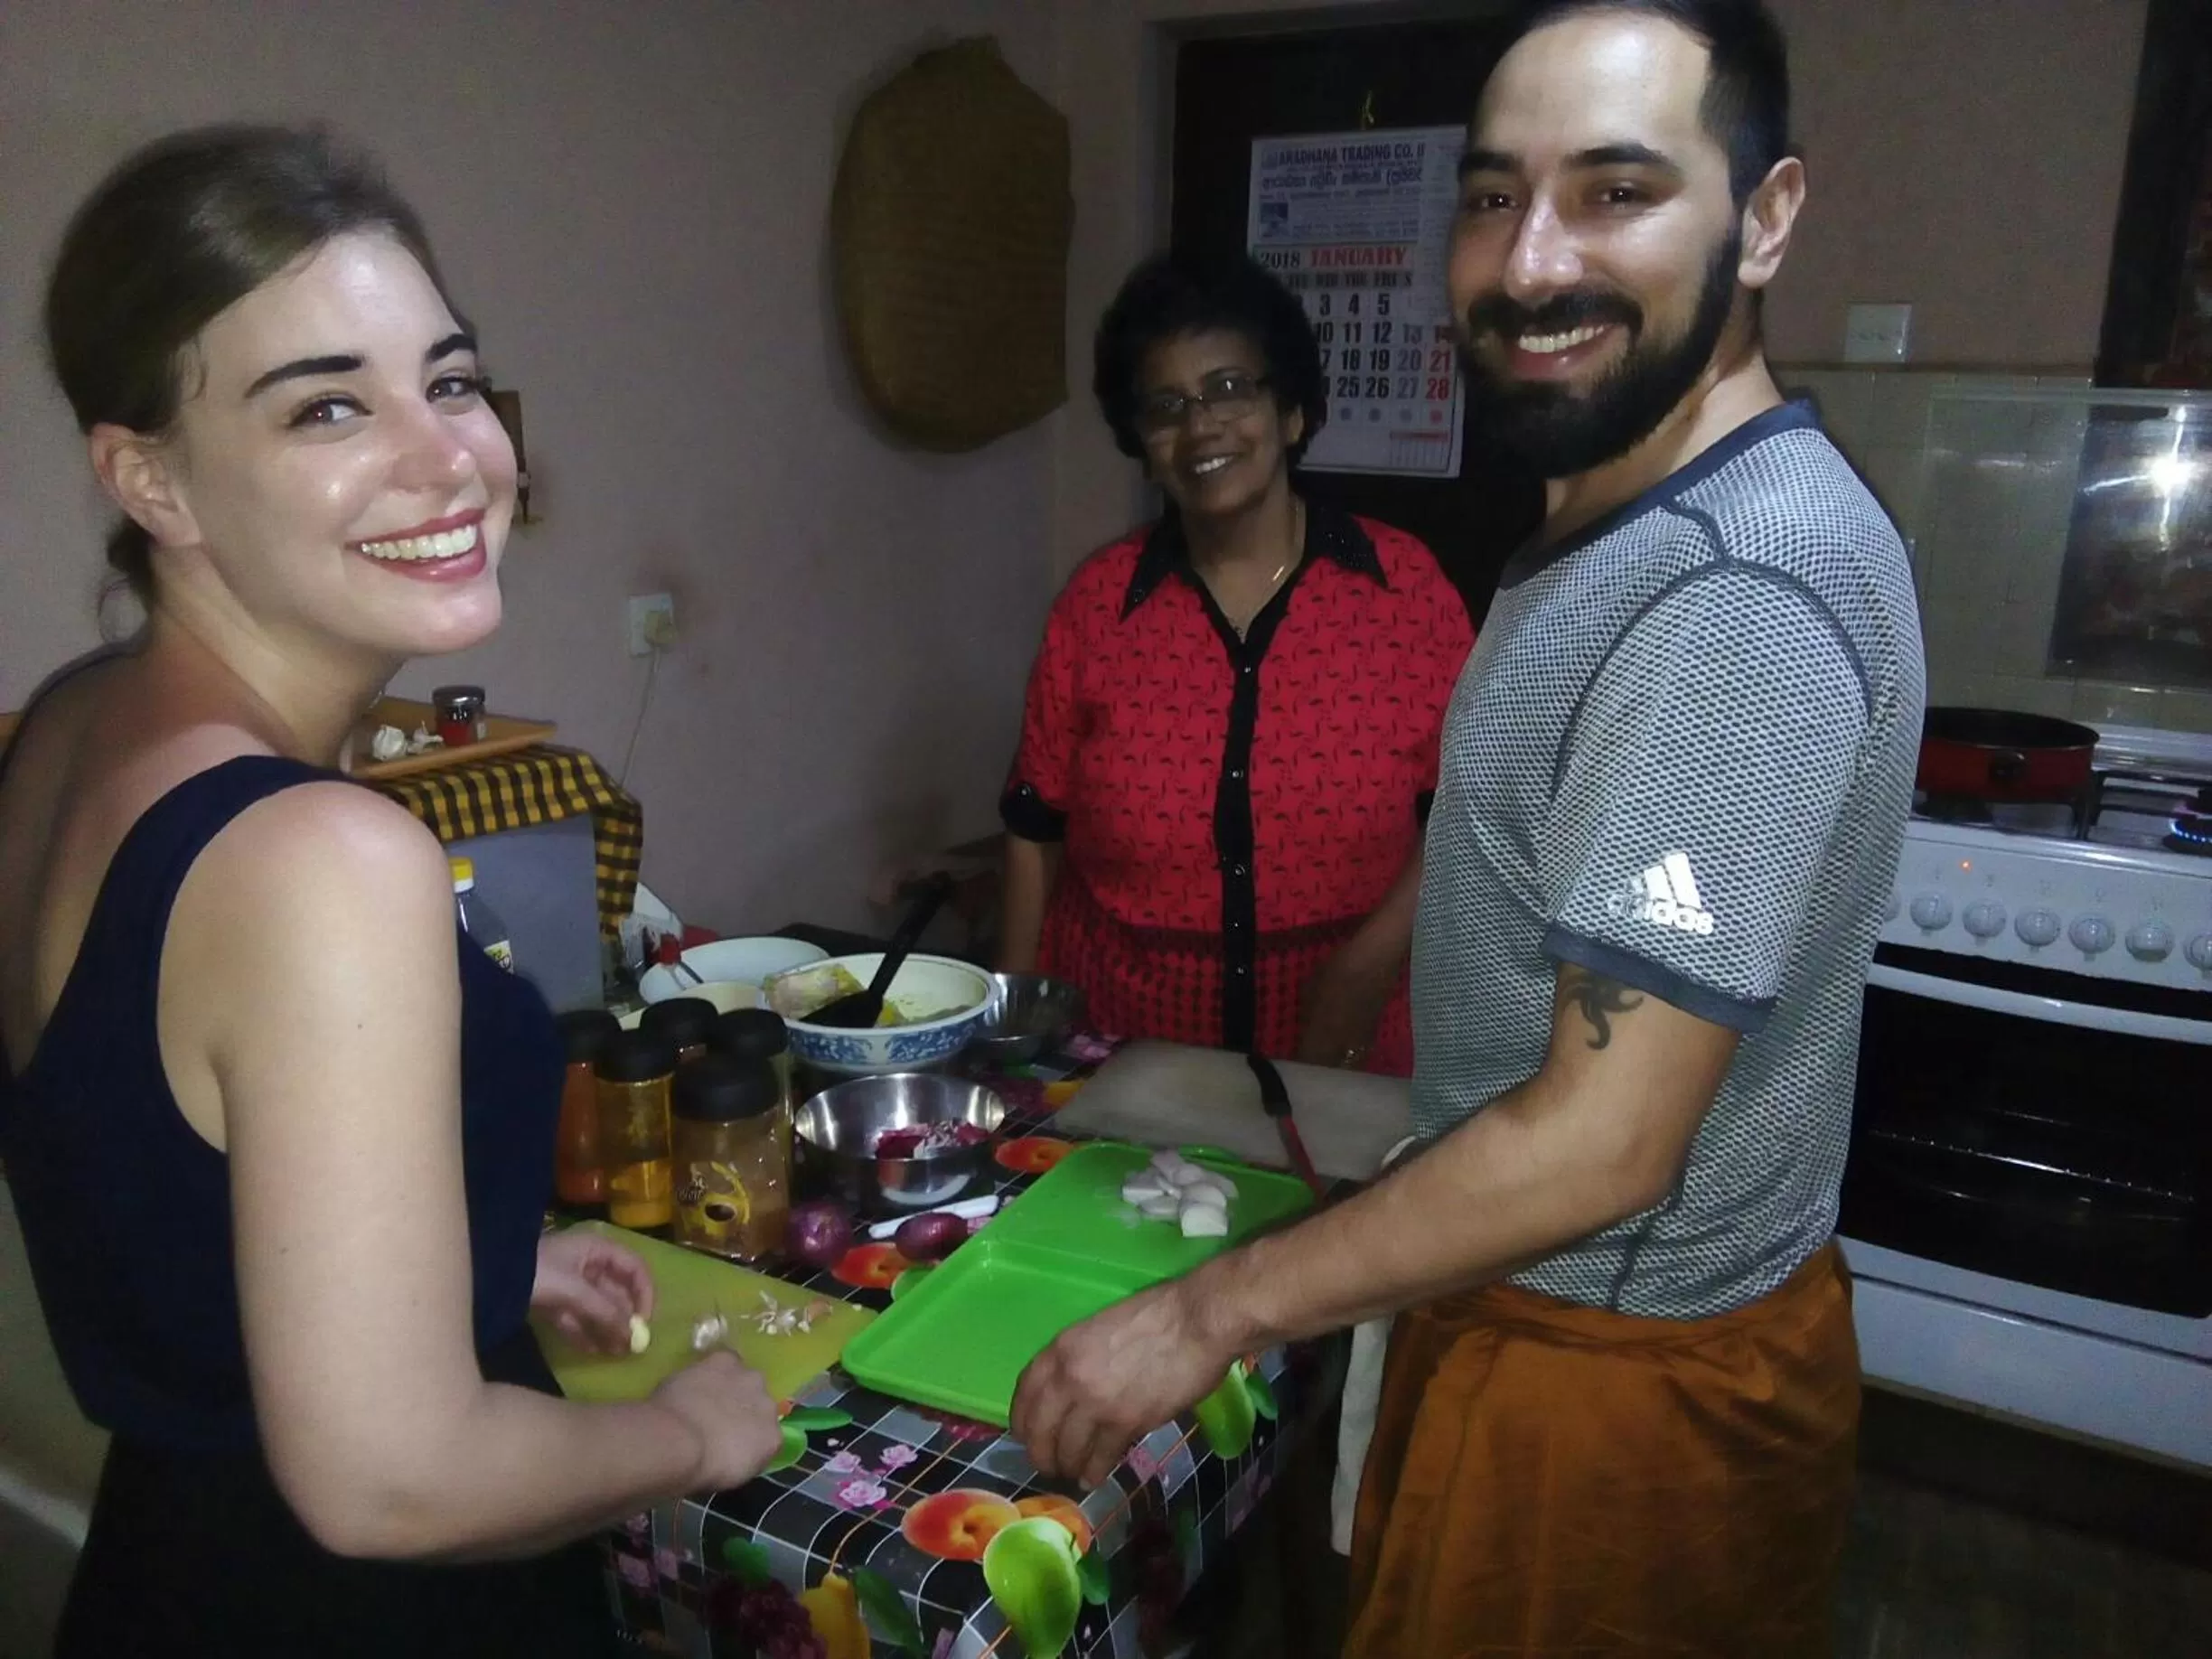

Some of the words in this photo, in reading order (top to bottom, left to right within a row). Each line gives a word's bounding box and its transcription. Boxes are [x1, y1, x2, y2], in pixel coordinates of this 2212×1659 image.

[1341, 143, 1391, 163] TRADING
[1394, 143, 1414, 159] CO.
[1261, 251, 1301, 268] 2018
[1310, 246, 1407, 267] JANUARY
[1319, 293, 1331, 315] 3
[1347, 293, 1360, 315] 4
[1377, 293, 1392, 315] 5
[1316, 322, 1334, 344] 10
[1344, 322, 1361, 344] 11
[1373, 321, 1392, 344] 12
[1401, 323, 1423, 343] 13
[1340, 348, 1361, 371] 18
[1369, 348, 1390, 371] 19
[1396, 349, 1421, 371] 20
[1429, 350, 1450, 373] 21
[1336, 375, 1359, 398] 25
[1364, 375, 1390, 398] 26
[1396, 377, 1420, 399] 27
[1424, 378, 1449, 400] 28
[1607, 889, 1714, 935] adidas
